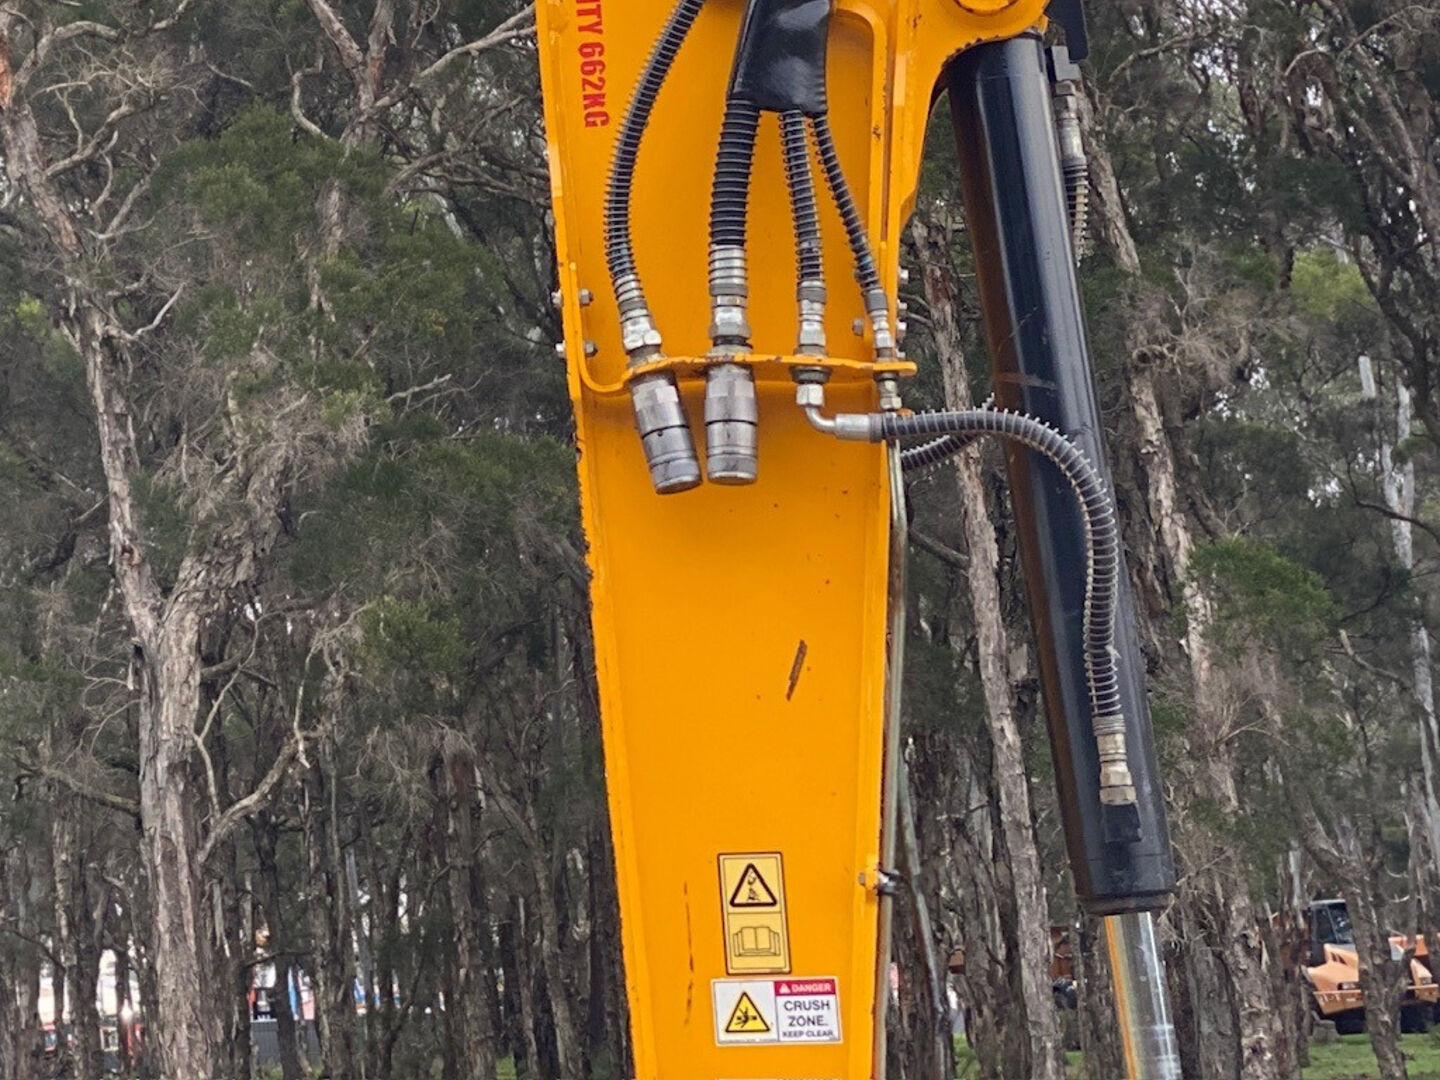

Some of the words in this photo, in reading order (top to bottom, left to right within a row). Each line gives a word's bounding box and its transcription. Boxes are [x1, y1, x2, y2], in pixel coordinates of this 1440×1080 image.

[577, 41, 610, 128] 662KG
[791, 983, 832, 993] DANGER
[783, 1000, 830, 1012] CRUSH
[782, 1030, 805, 1039] KEEP
[806, 1030, 833, 1038] CLEAR
